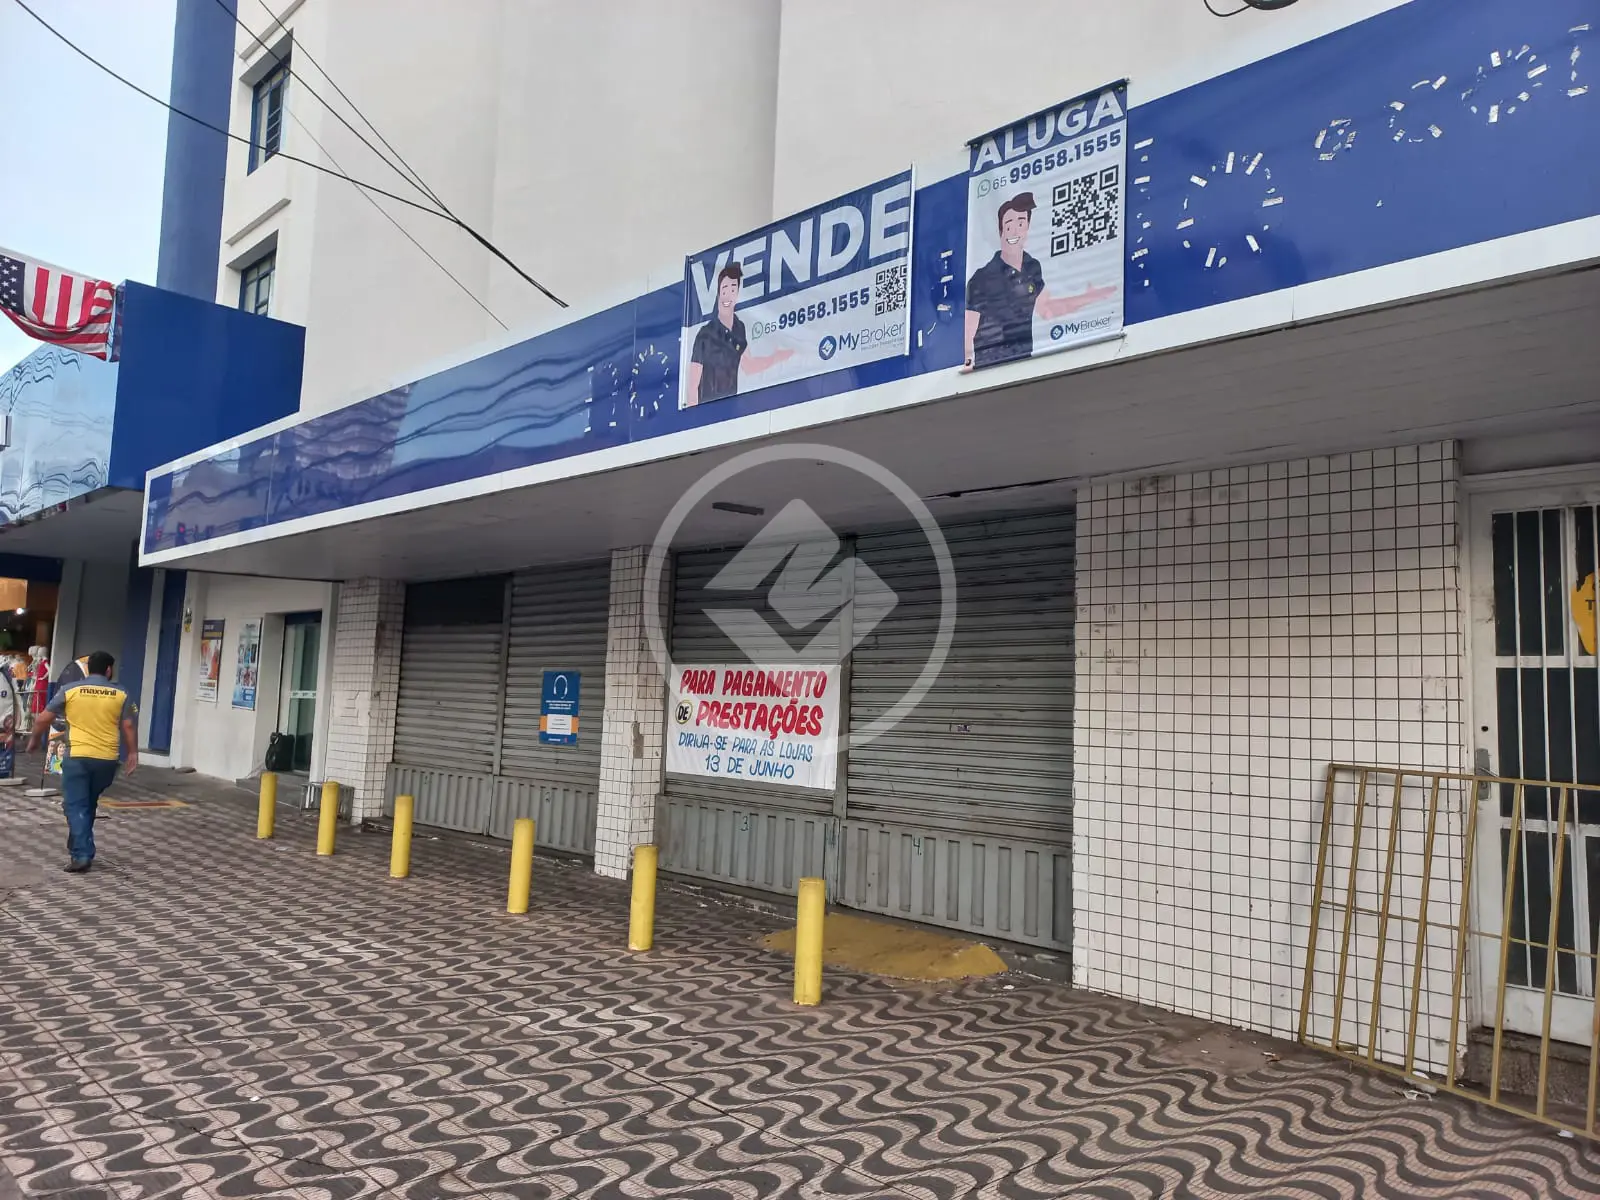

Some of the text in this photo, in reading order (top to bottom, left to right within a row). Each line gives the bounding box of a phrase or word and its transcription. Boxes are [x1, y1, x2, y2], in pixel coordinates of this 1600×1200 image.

[973, 88, 1123, 173] ALUGA
[992, 129, 1121, 190] 65 99658.1555
[690, 180, 910, 315] VENDE
[764, 287, 870, 335] 65 99658.1555
[1065, 316, 1112, 334] MyBroker
[839, 321, 904, 351] MyBroker
[80, 688, 117, 697] maxvinil
[680, 669, 828, 699] PARA PAGAMENTO
[677, 698, 824, 740] DE PRESTAÇÕES
[678, 732, 813, 762] DIRIJA-SE PARA AS LOJAS
[705, 754, 794, 779] 13 DE JUNHO
[740, 816, 749, 832] 3
